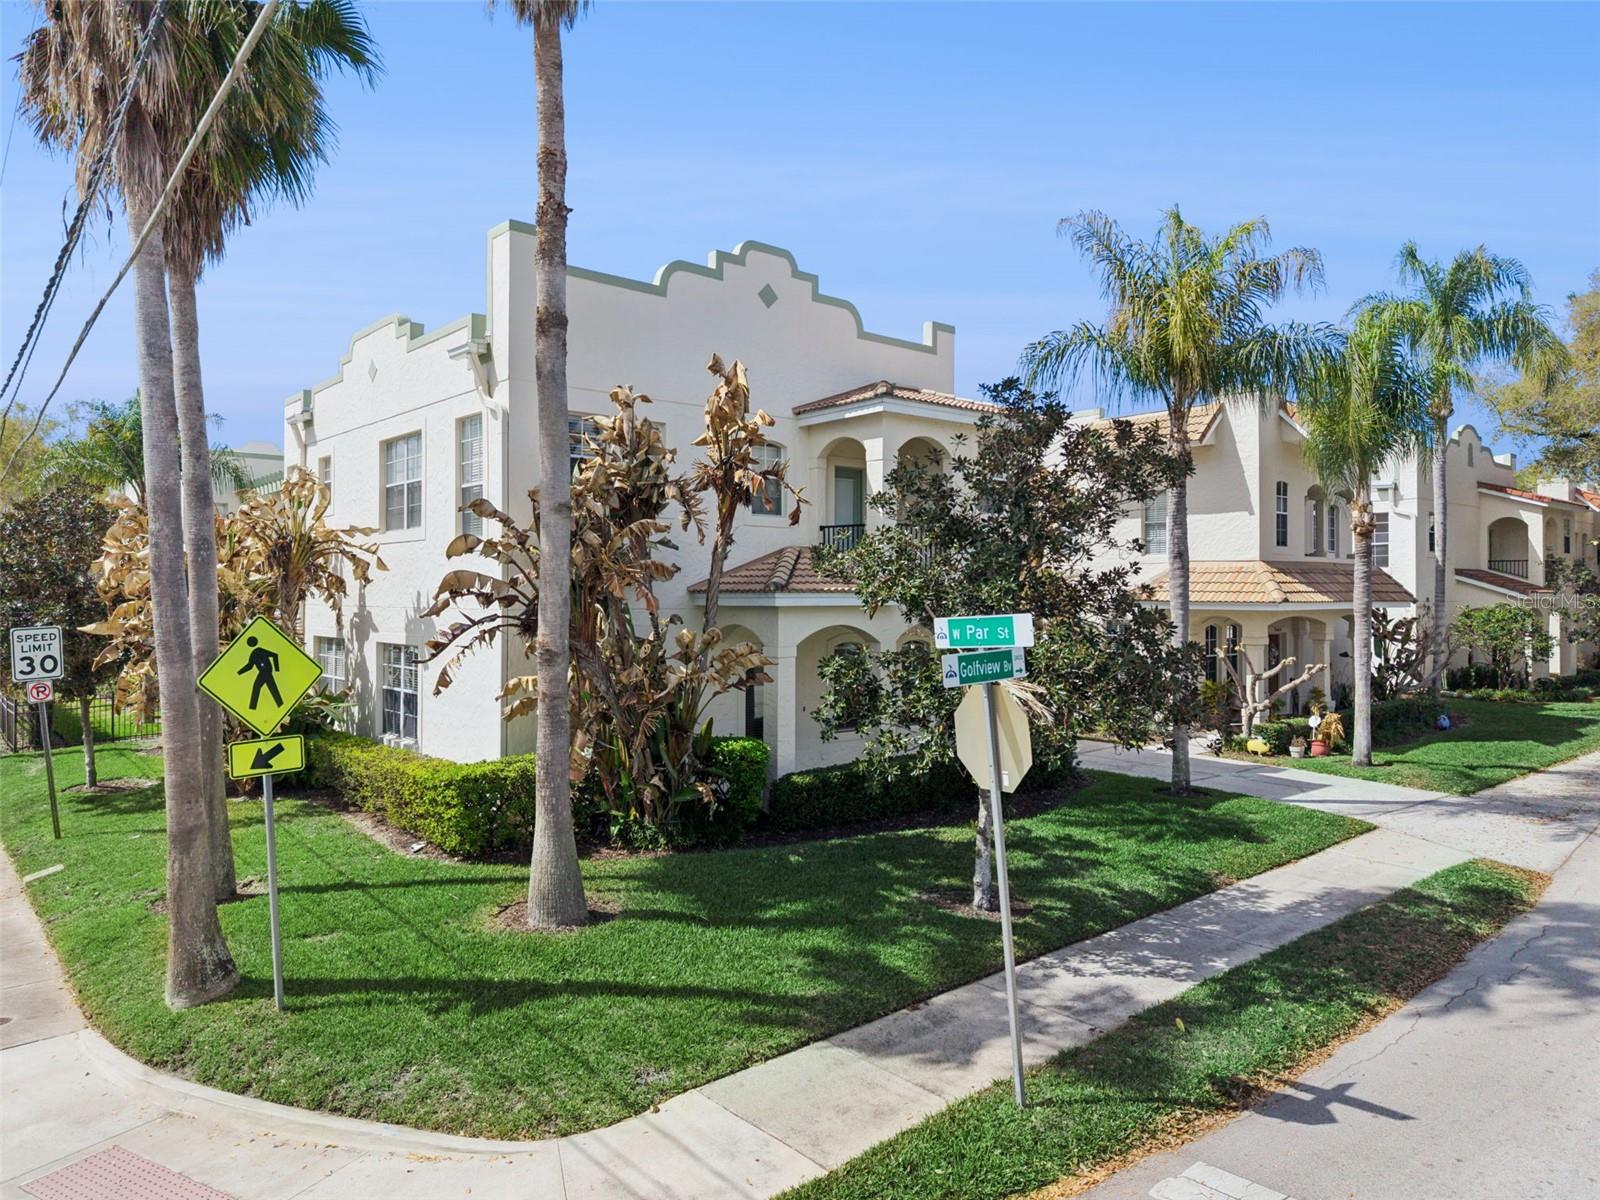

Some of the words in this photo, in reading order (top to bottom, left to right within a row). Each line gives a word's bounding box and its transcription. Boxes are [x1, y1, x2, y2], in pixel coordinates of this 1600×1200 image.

[16, 632, 57, 643] SPEED
[966, 624, 990, 640] Par
[997, 626, 1010, 640] St
[21, 643, 53, 654] LIMIT
[18, 654, 59, 676] 30
[960, 659, 1001, 678] Golfview
